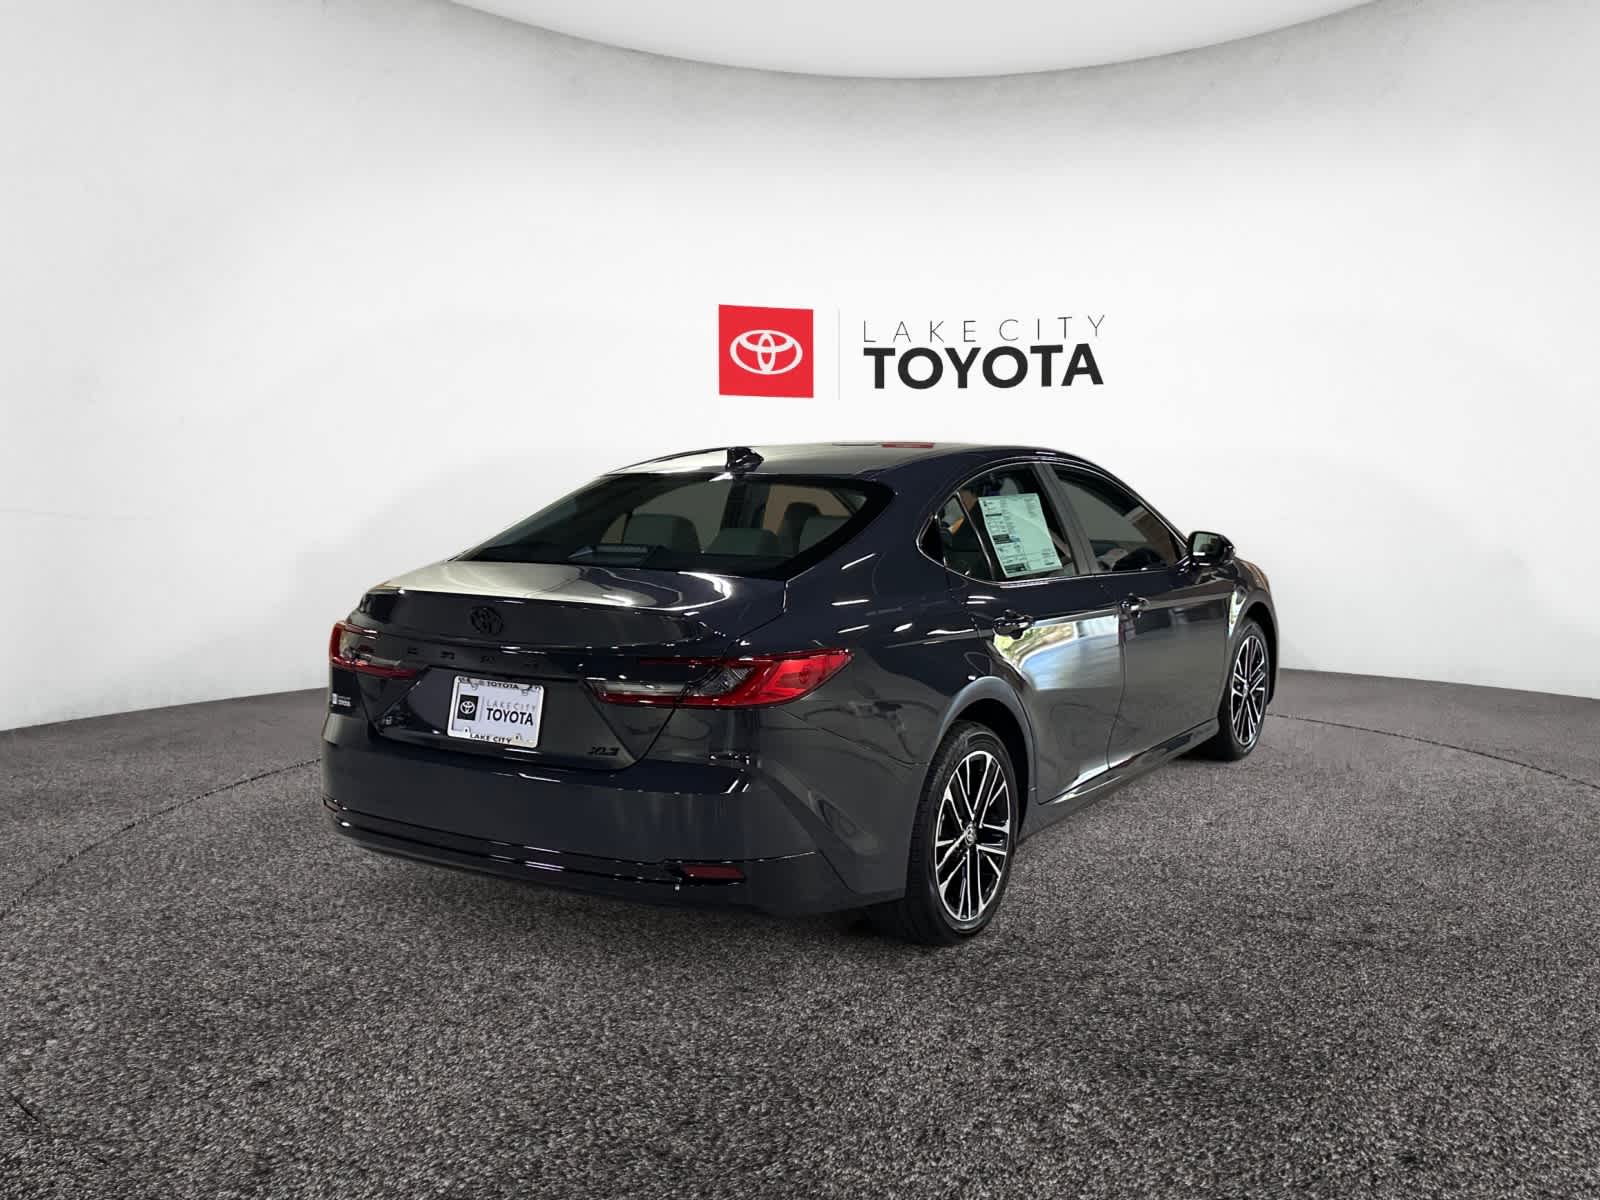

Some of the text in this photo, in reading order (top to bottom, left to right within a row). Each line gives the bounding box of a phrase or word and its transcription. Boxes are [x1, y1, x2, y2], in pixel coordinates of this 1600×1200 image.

[863, 314, 1106, 343] LAKE CITY
[863, 343, 1104, 390] TOYOTA
[487, 681, 519, 690] TOYOTA
[486, 699, 537, 712] LAKE CITY
[486, 707, 534, 726] TOYOTA
[470, 733, 512, 744] LAKE CITY
